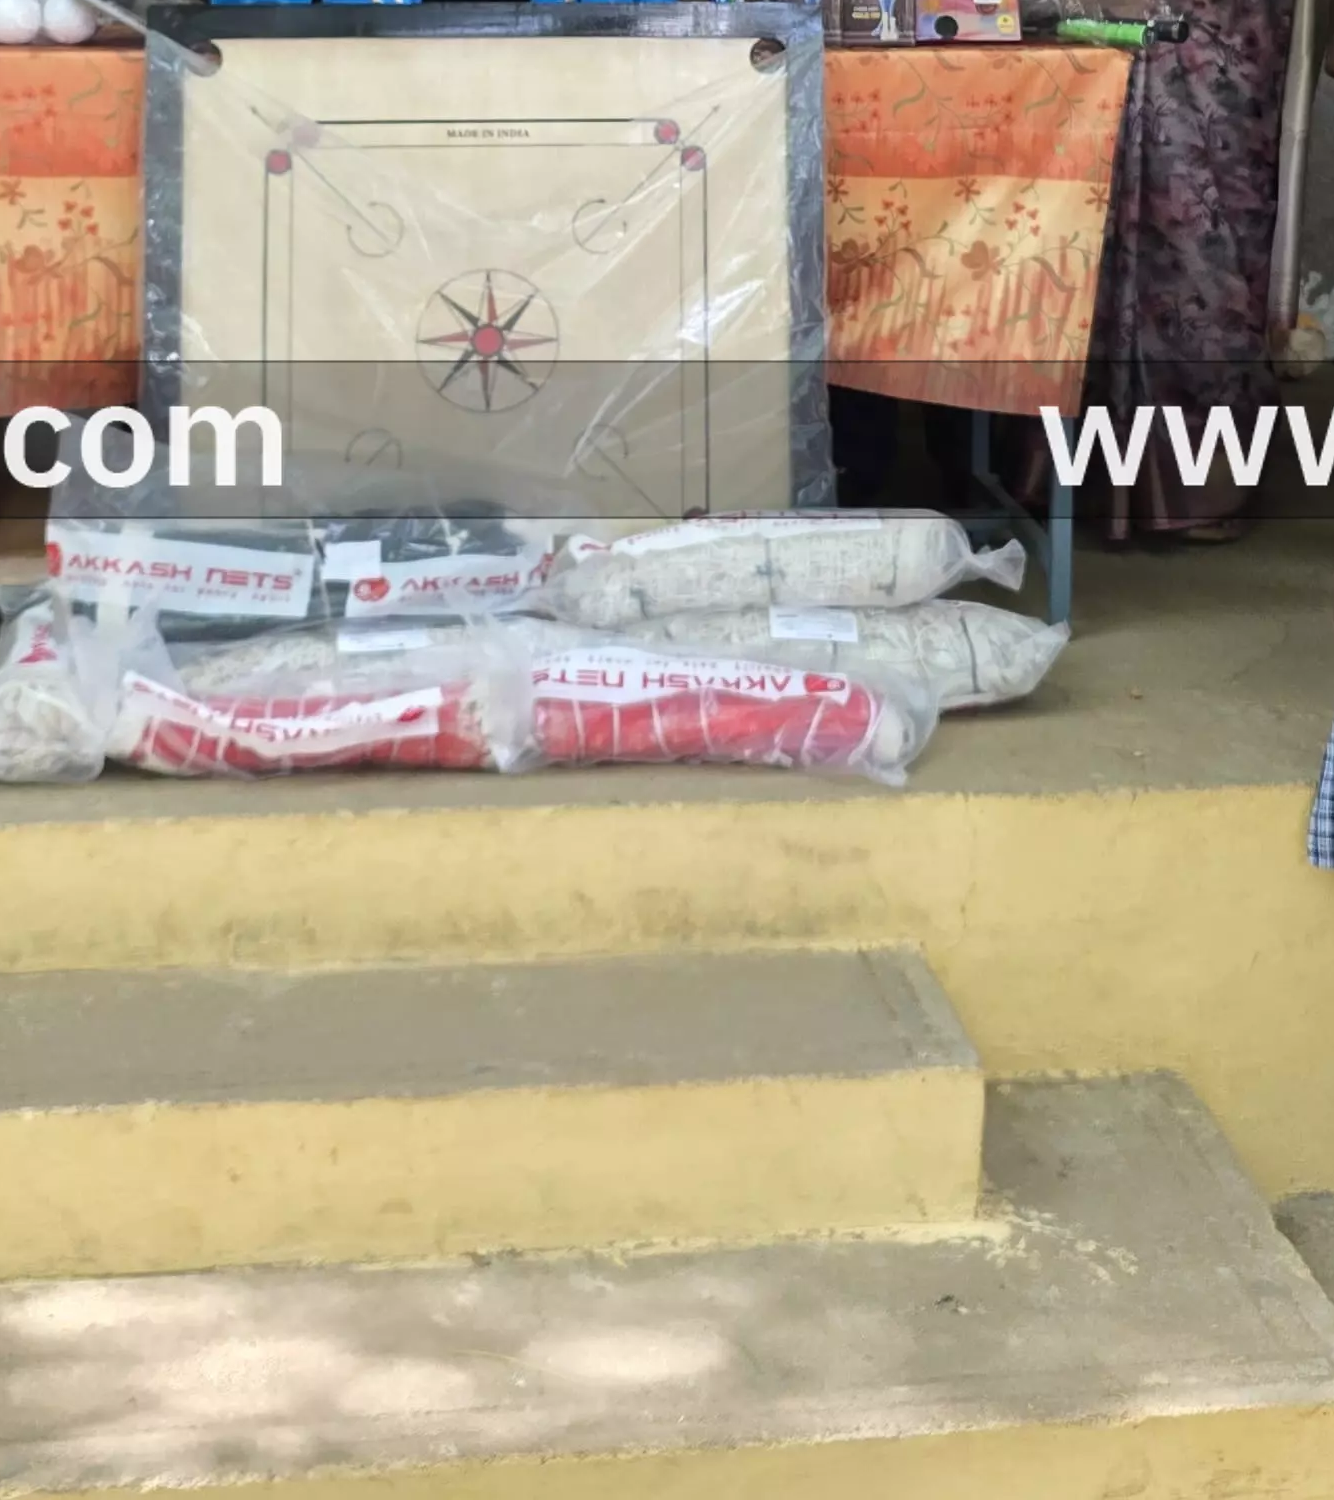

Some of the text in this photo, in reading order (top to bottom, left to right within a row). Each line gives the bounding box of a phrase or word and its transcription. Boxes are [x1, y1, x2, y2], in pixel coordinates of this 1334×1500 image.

[447, 128, 530, 138] MADE IN INDIA
[68, 553, 193, 582] AKKASH
[206, 566, 294, 591] NETS
